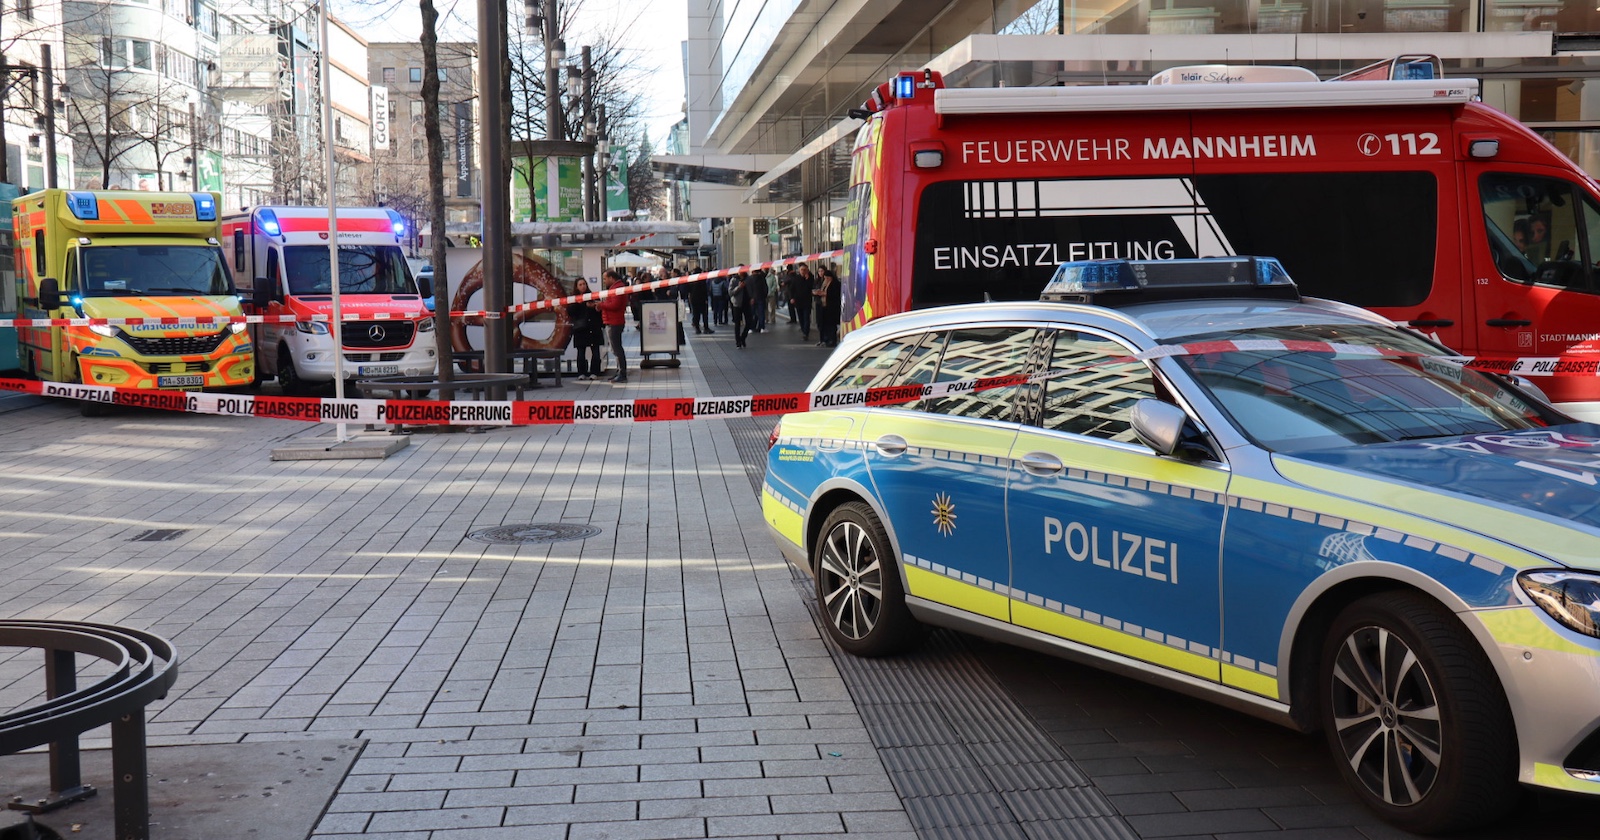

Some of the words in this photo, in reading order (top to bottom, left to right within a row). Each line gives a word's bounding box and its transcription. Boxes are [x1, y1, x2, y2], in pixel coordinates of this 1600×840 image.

[1181, 73, 1202, 81] Telair
[961, 138, 1131, 164] FEUERWEHR
[1143, 134, 1317, 160] MANNHEIM
[1384, 132, 1441, 156] 112
[164, 203, 194, 215] ASB
[933, 239, 1176, 270] EINSATZLEITUNG
[176, 376, 186, 384] SB
[374, 366, 382, 374] MA
[216, 398, 359, 419] POLIZEIABSPERRUNG
[377, 404, 511, 421] POLIZEIABSPERRUNG
[529, 402, 658, 420] POLIZEIABSPERRUNG
[674, 397, 799, 417] POLIZEIABSPERRUNG
[814, 385, 933, 408] POLIZEIABSPERRUNG
[1044, 516, 1178, 585] POLIZEI
